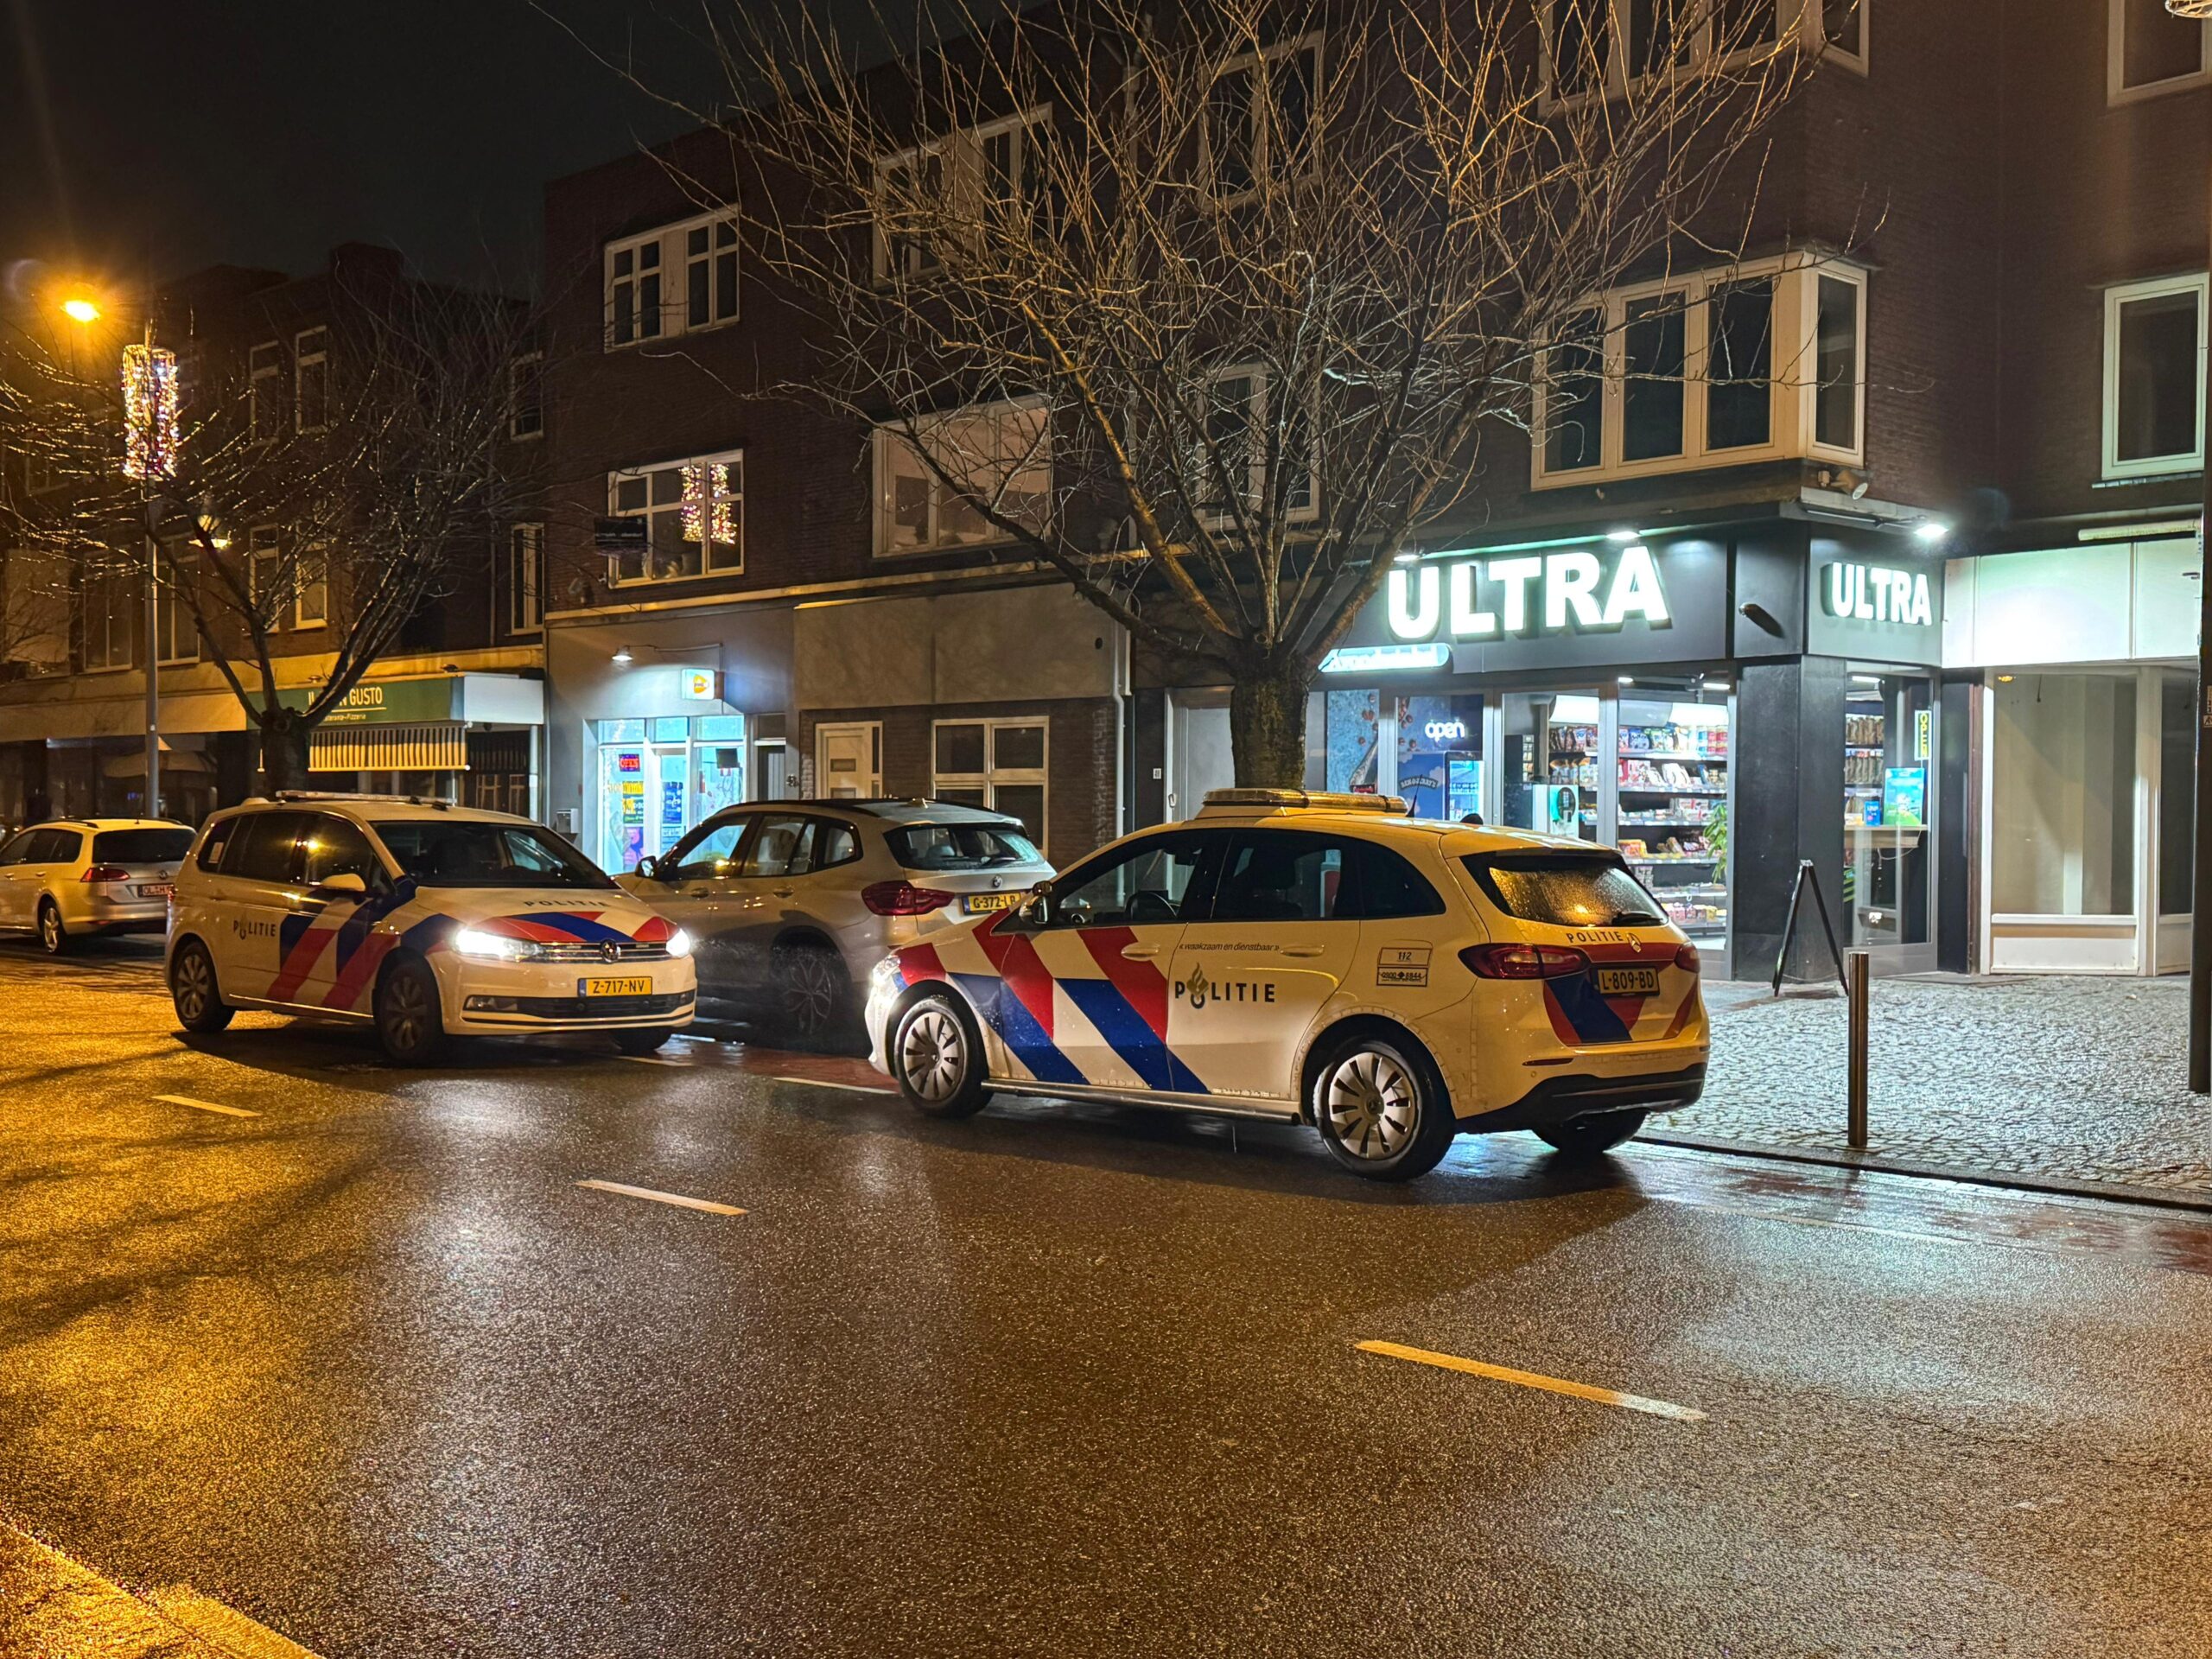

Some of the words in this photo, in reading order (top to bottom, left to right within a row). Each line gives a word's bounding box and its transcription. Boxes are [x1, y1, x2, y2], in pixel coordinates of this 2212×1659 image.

[1389, 546, 1669, 639] ULTRA
[1832, 562, 1932, 626] ULTRA
[349, 687, 384, 706] GUSTO
[1425, 721, 1465, 741] open
[1919, 713, 1929, 757] OPEN
[233, 920, 276, 940] POLITIE
[1566, 931, 1624, 944] POLITIE
[1185, 942, 1224, 950] waakzaam
[1234, 942, 1274, 950] dienstbaar
[1398, 951, 1412, 961] 112
[593, 980, 645, 995] Z-717-NV
[1601, 970, 1654, 990] L-809-BD
[1175, 980, 1275, 1009] POLITIE
